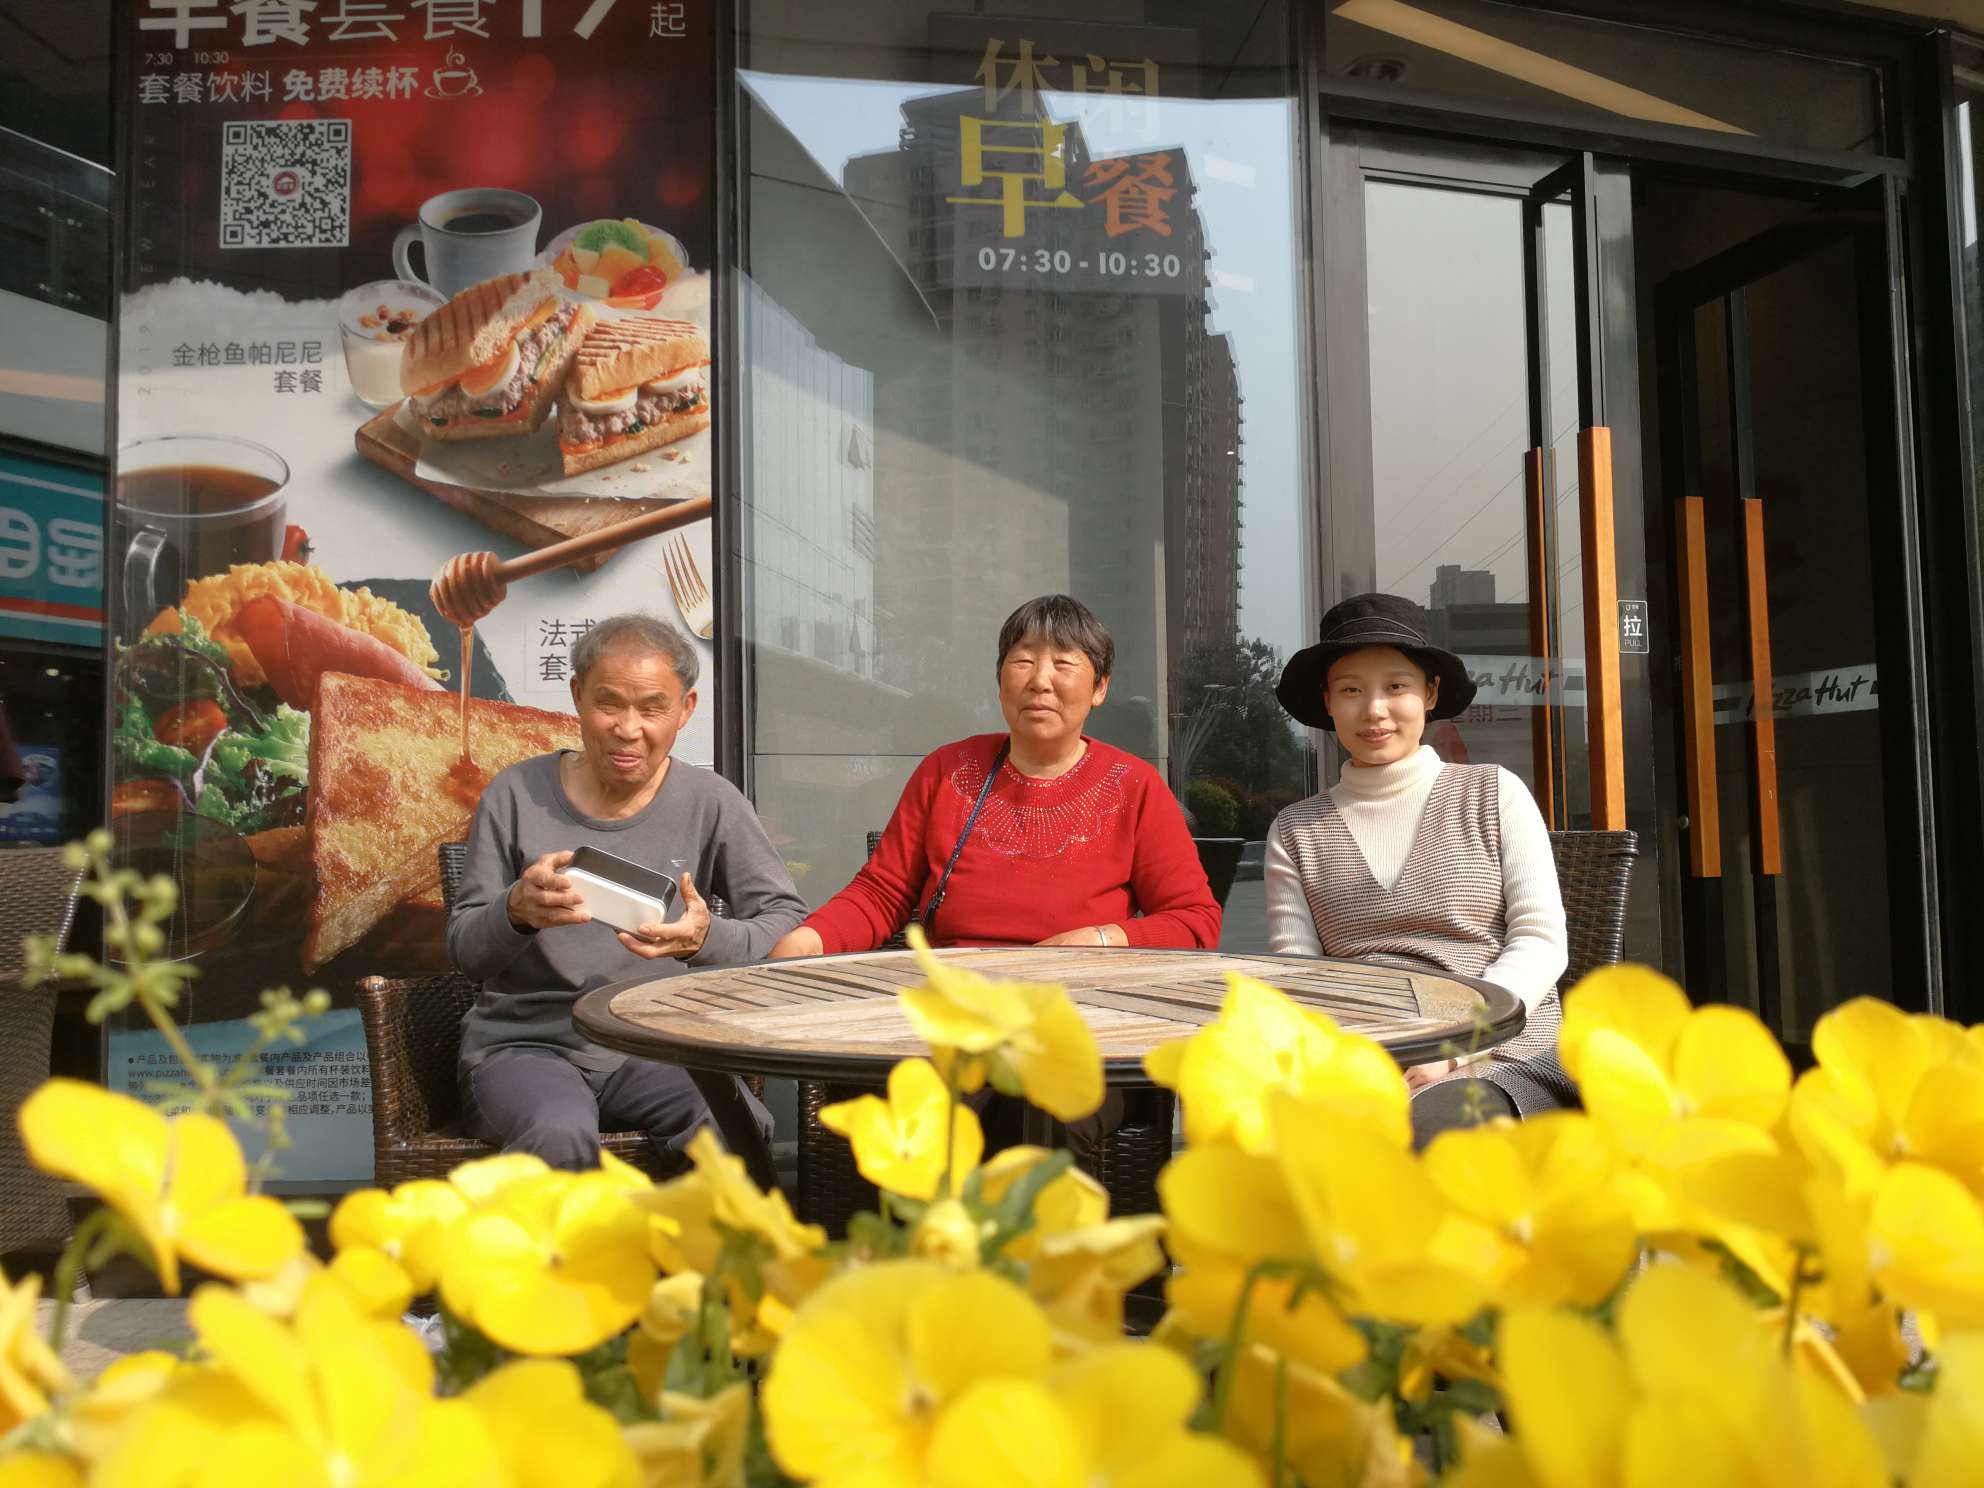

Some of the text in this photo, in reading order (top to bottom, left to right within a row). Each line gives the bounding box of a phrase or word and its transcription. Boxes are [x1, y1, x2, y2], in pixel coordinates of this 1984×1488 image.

[650, 3, 686, 38] 起
[144, 51, 230, 65] 7:30 10:30
[138, 66, 420, 104] 套餐饮料 免费续杯
[974, 37, 1161, 141] 休闲
[946, 114, 1178, 238] 早餐
[172, 341, 323, 367] 金枪鱼帕尼尼
[273, 369, 323, 393] 套餐
[538, 617, 597, 649] 法式
[1623, 614, 1643, 637] 拉
[1624, 638, 1642, 648] PULL
[538, 652, 577, 682] 套
[1498, 662, 1562, 695] Hut
[1814, 675, 1869, 706] Hut
